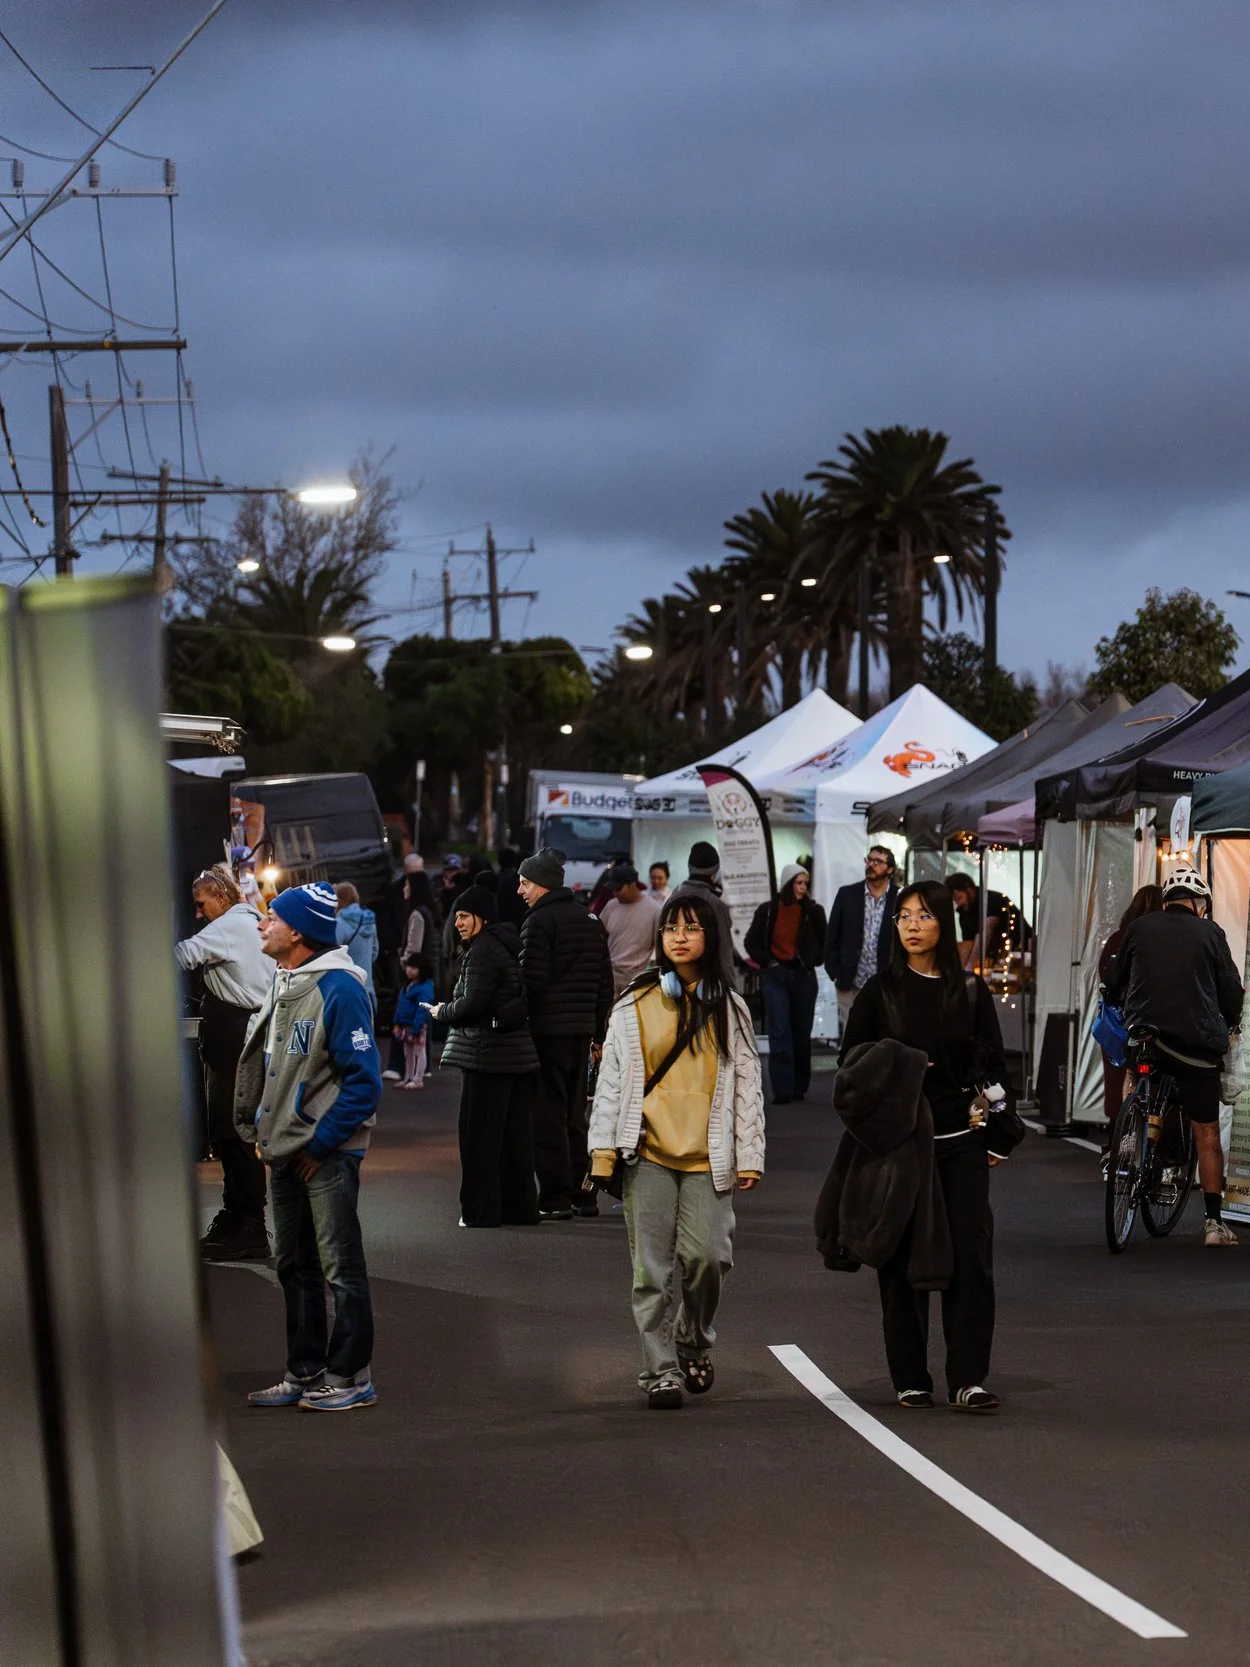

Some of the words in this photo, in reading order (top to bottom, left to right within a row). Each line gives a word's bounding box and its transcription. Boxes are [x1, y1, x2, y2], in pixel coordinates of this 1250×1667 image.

[1173, 770, 1203, 780] HEAVY
[571, 791, 632, 811] Budget
[287, 1020, 315, 1055] N
